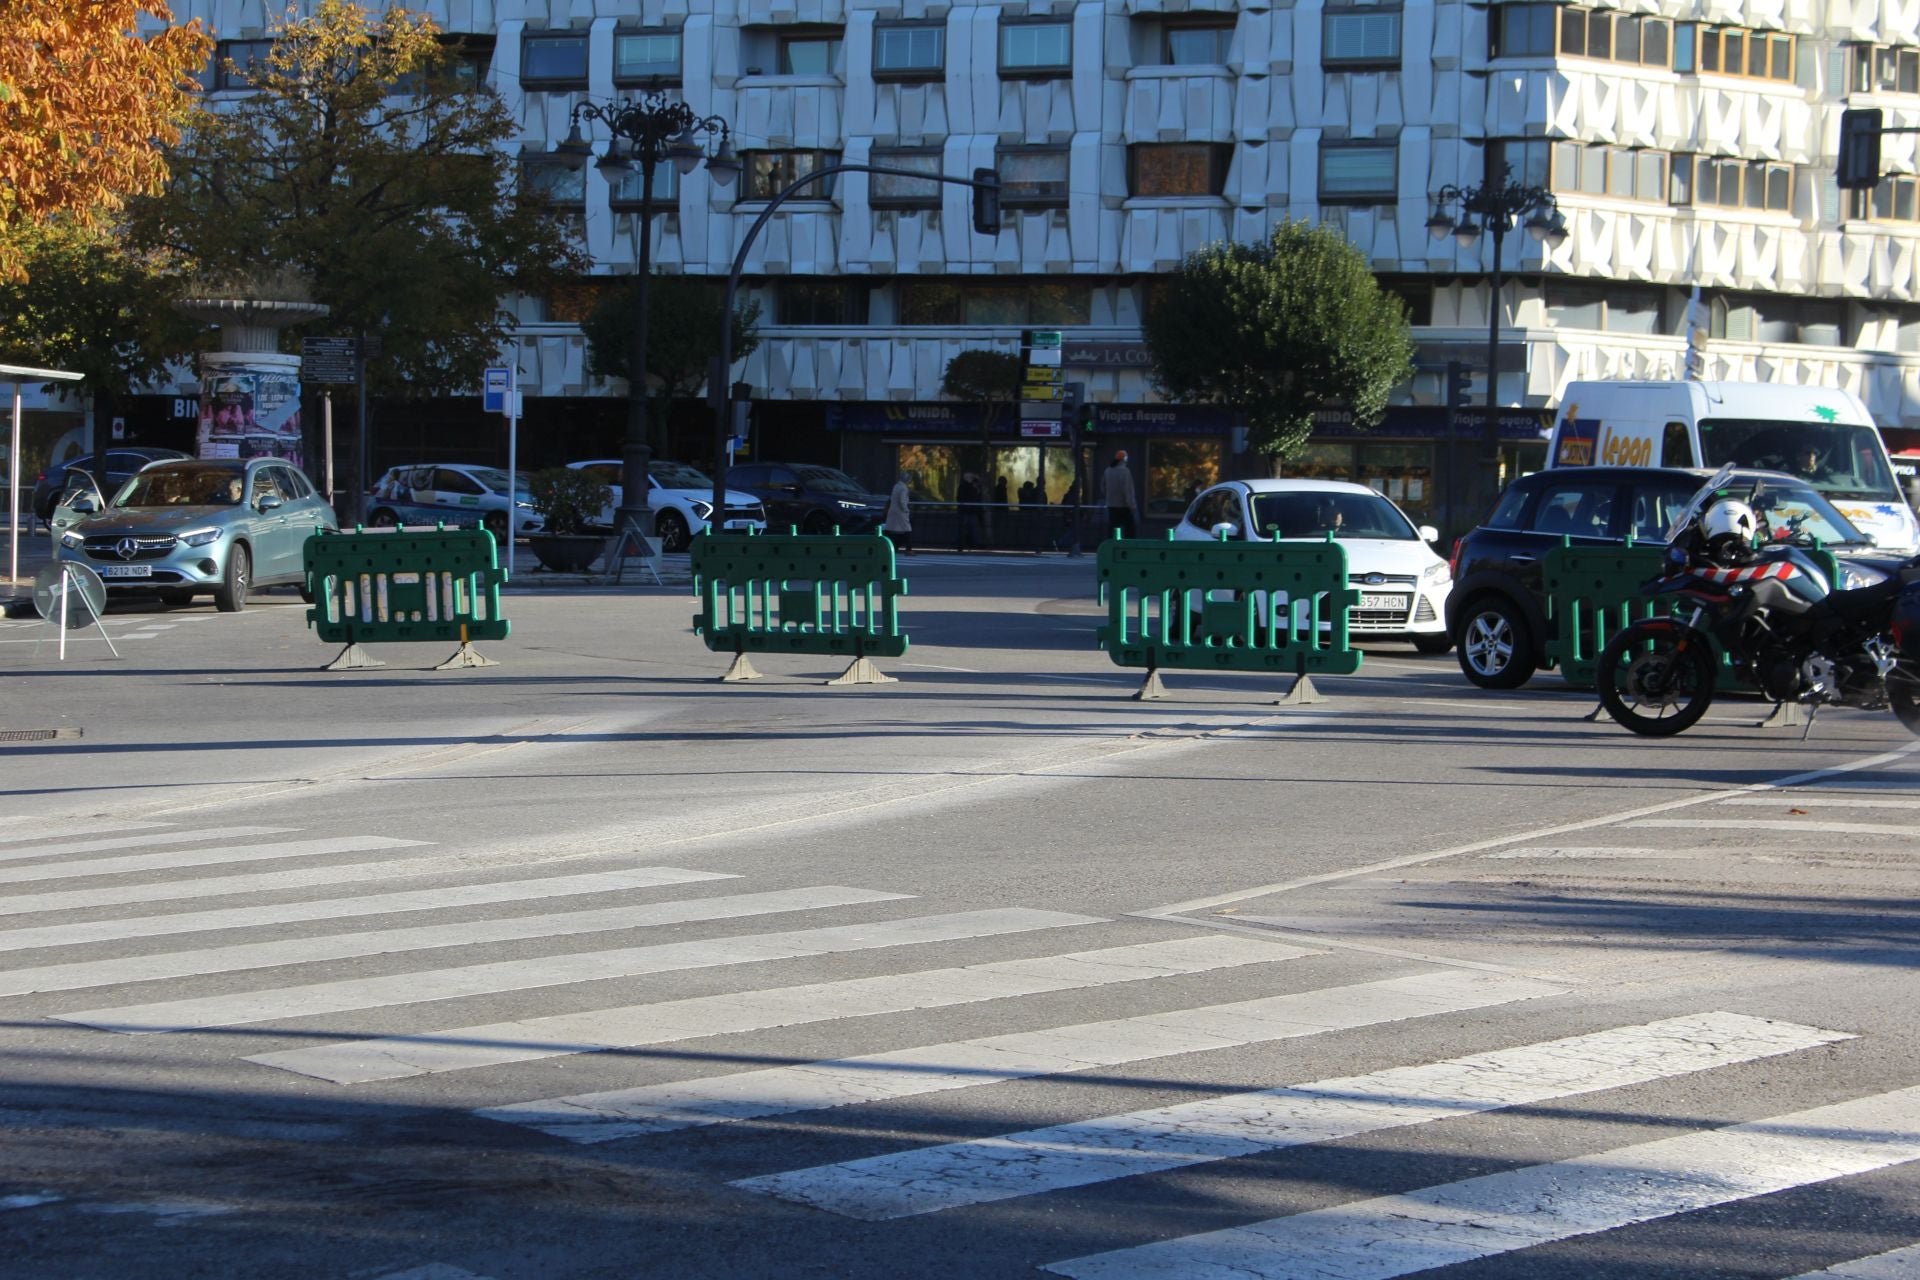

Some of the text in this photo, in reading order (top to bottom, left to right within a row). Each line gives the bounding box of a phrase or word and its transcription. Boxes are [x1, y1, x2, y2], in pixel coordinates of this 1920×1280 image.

[1312, 410, 1352, 423] NIDA
[108, 567, 148, 576] 6212 NDR
[1383, 596, 1405, 608] HCN
